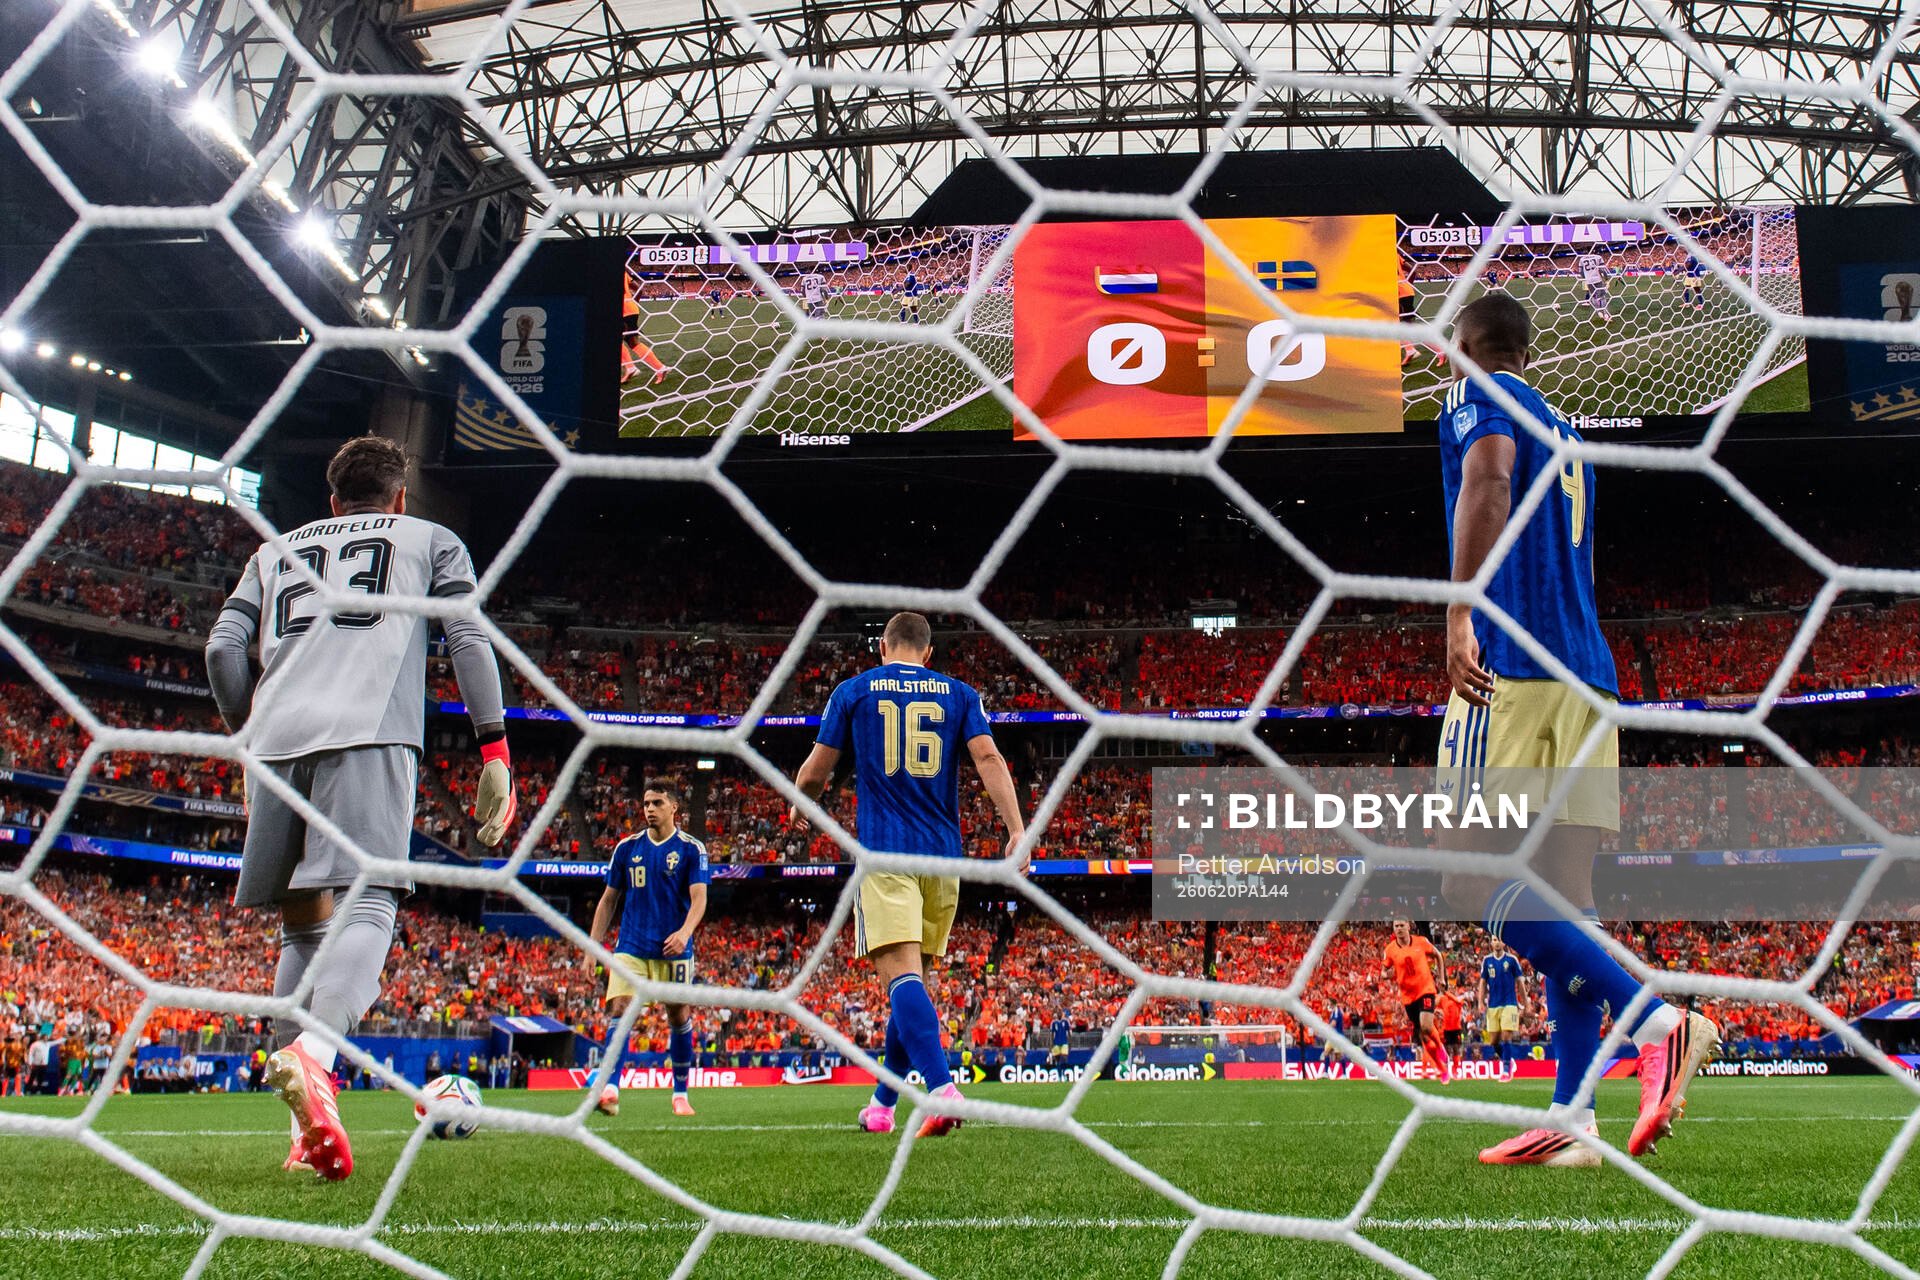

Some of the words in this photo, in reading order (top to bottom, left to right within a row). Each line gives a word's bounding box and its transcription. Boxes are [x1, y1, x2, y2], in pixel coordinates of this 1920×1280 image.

[1420, 231, 1460, 242] 05:03
[649, 250, 688, 262] 05:03
[1886, 352, 1920, 362] 202
[510, 383, 544, 393] 026
[1571, 416, 1643, 428] Hisense
[780, 433, 850, 446] Hisense
[1553, 425, 1586, 548] 4
[288, 518, 399, 542] NORDFELDT
[275, 537, 396, 640] 23
[146, 680, 163, 689] FIFA
[164, 683, 192, 694] WORLD
[193, 687, 210, 697] CUP
[870, 678, 950, 695] KARLSTRÖM
[1817, 693, 1834, 701] CUP
[1835, 691, 1866, 699] 2026
[588, 713, 606, 721] FIFA
[607, 714, 637, 722] WORLD
[764, 717, 806, 725] HOUSTON
[878, 700, 945, 778] 16
[1445, 719, 1460, 768] 4
[184, 801, 203, 811] FIFA
[205, 803, 234, 814] WORLD
[171, 851, 190, 863] FIFA
[191, 854, 226, 867] WORLD
[1617, 855, 1672, 864] HOUSTON
[535, 863, 559, 873] FIFA
[560, 864, 599, 875] WORLD
[782, 866, 836, 876] HOUSTON
[629, 866, 646, 888] 18
[195, 1061, 214, 1077] IFA
[1114, 1063, 1200, 1081] Globant
[1743, 1060, 1829, 1077] Rapidísimo
[619, 1067, 737, 1088] Valvline
